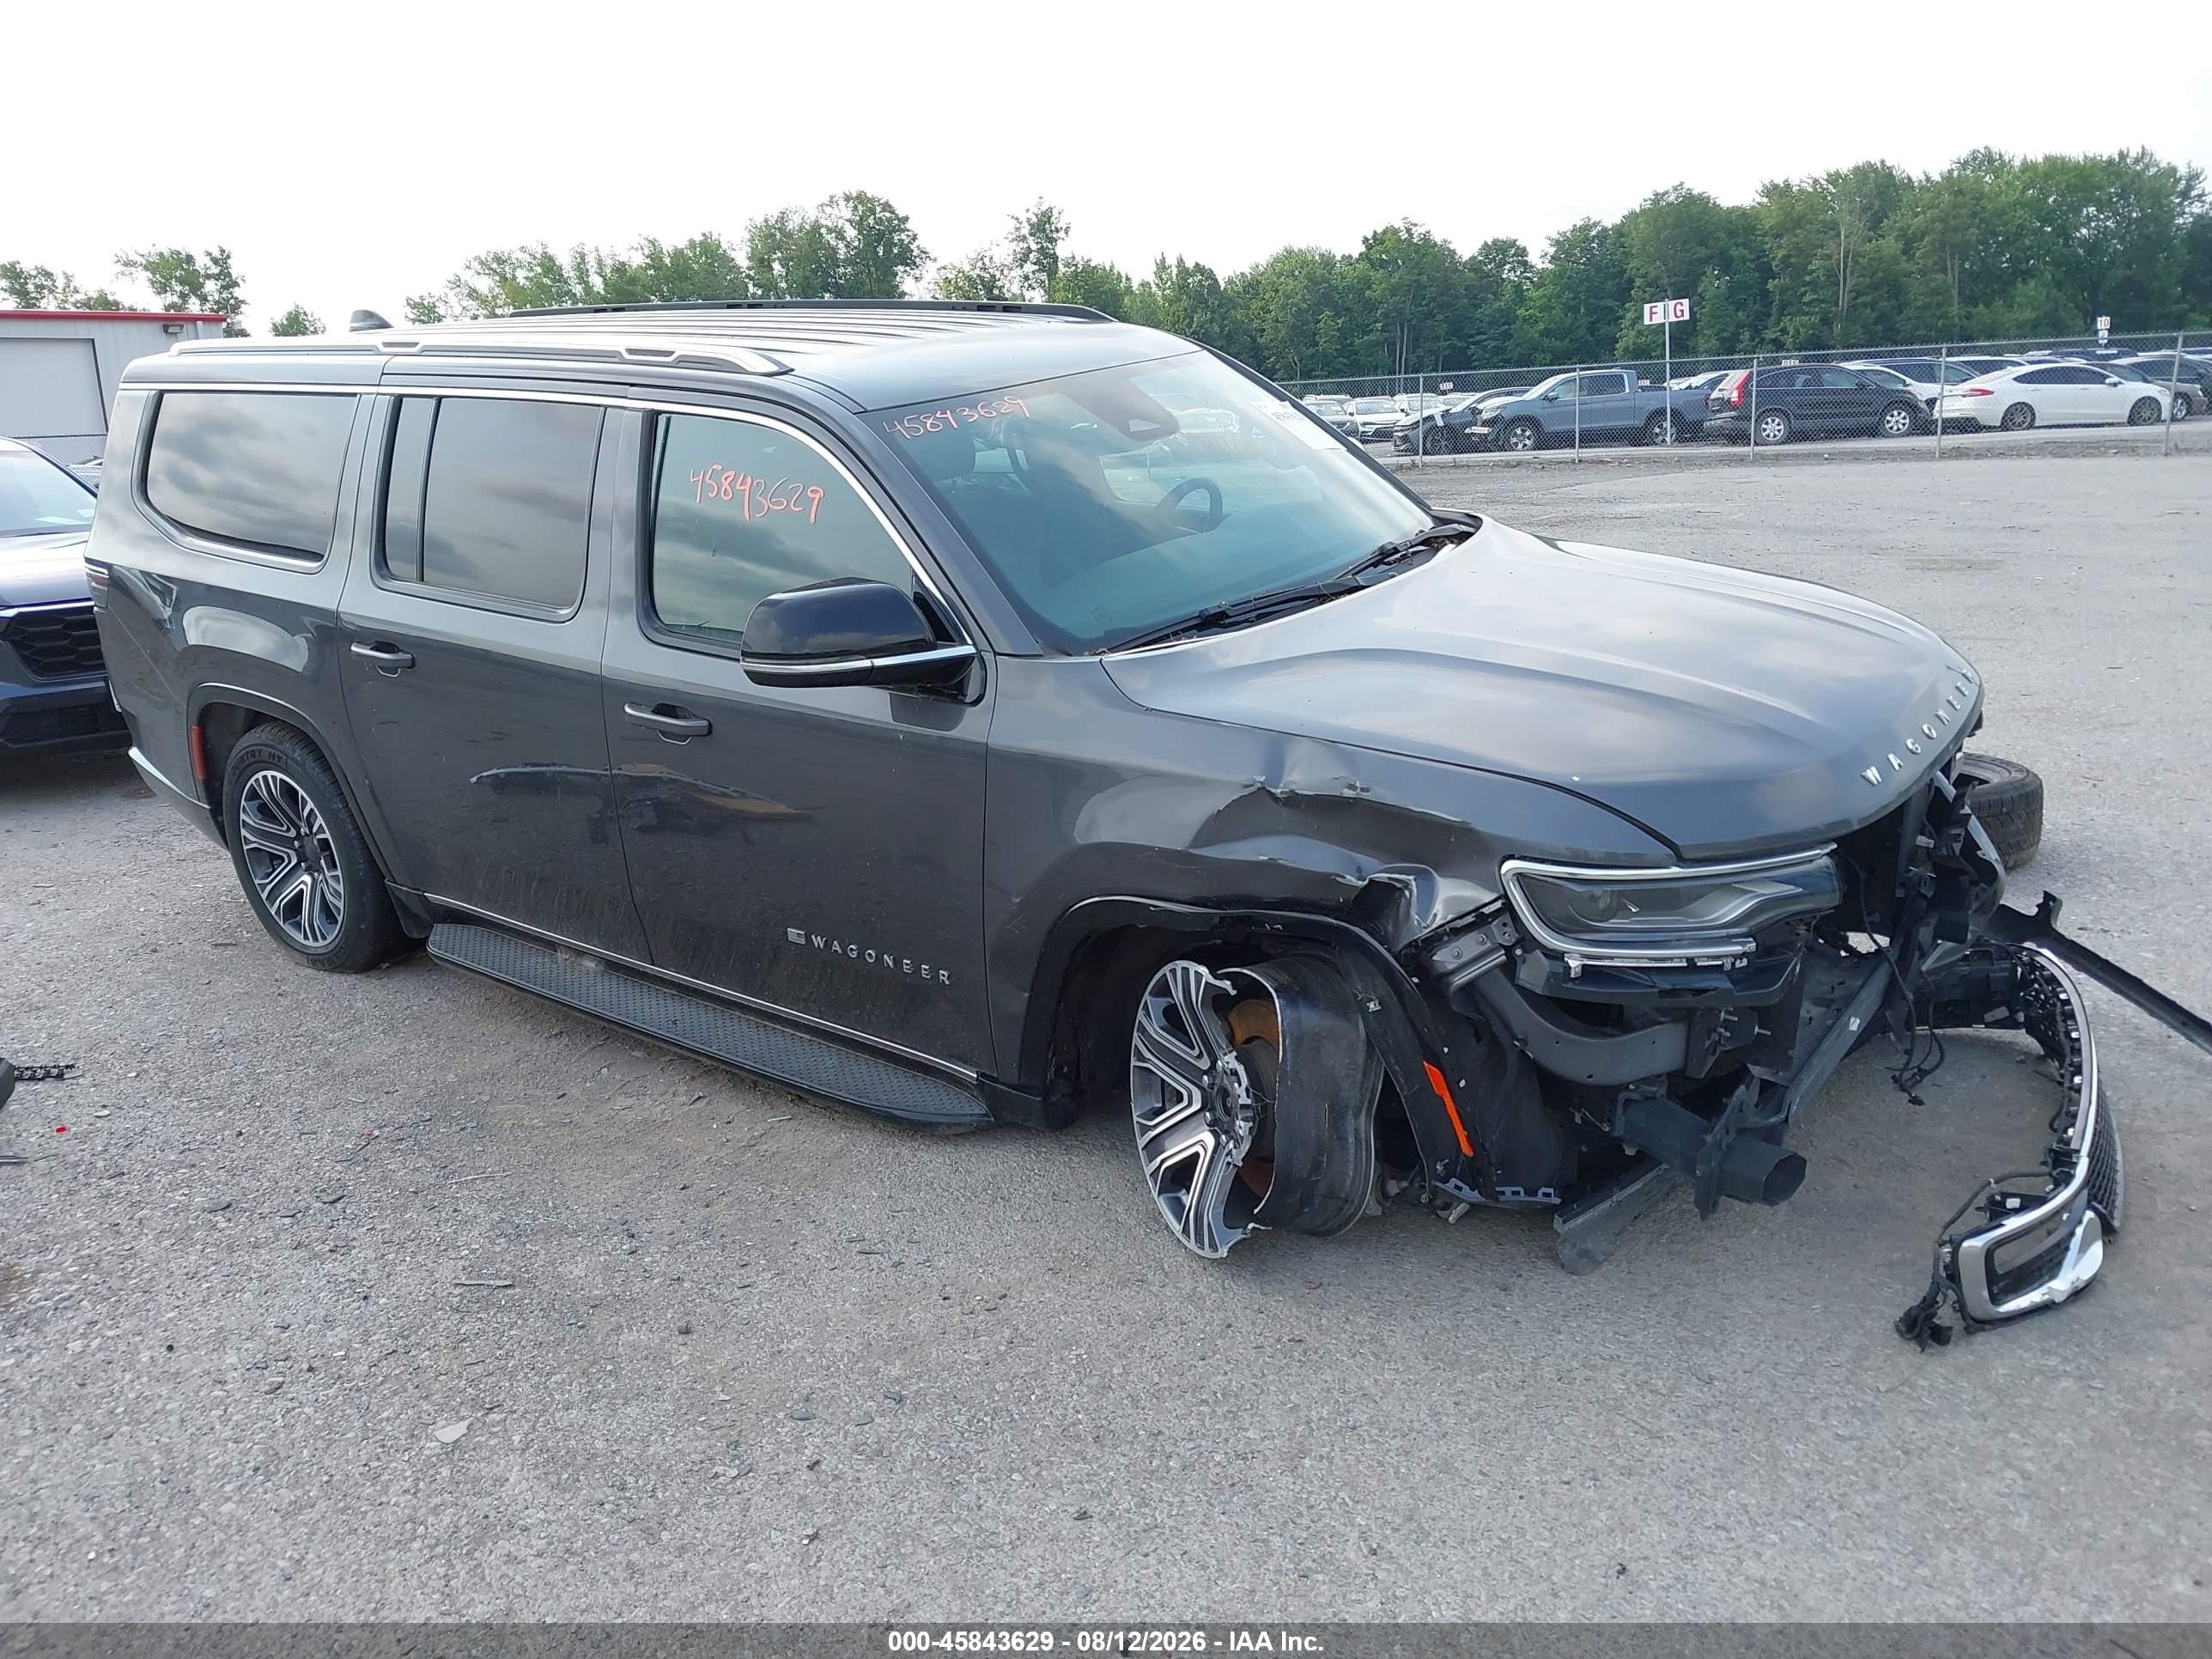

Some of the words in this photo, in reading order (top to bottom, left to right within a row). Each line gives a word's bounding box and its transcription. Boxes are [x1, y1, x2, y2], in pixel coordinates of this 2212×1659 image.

[1649, 306, 1658, 322] F
[1674, 301, 1684, 319] G
[2099, 318, 2109, 327] 10
[883, 395, 1030, 440] 45843629
[690, 463, 824, 525] 45843629
[267, 751, 284, 763] HT
[811, 933, 950, 985] WAGONEER
